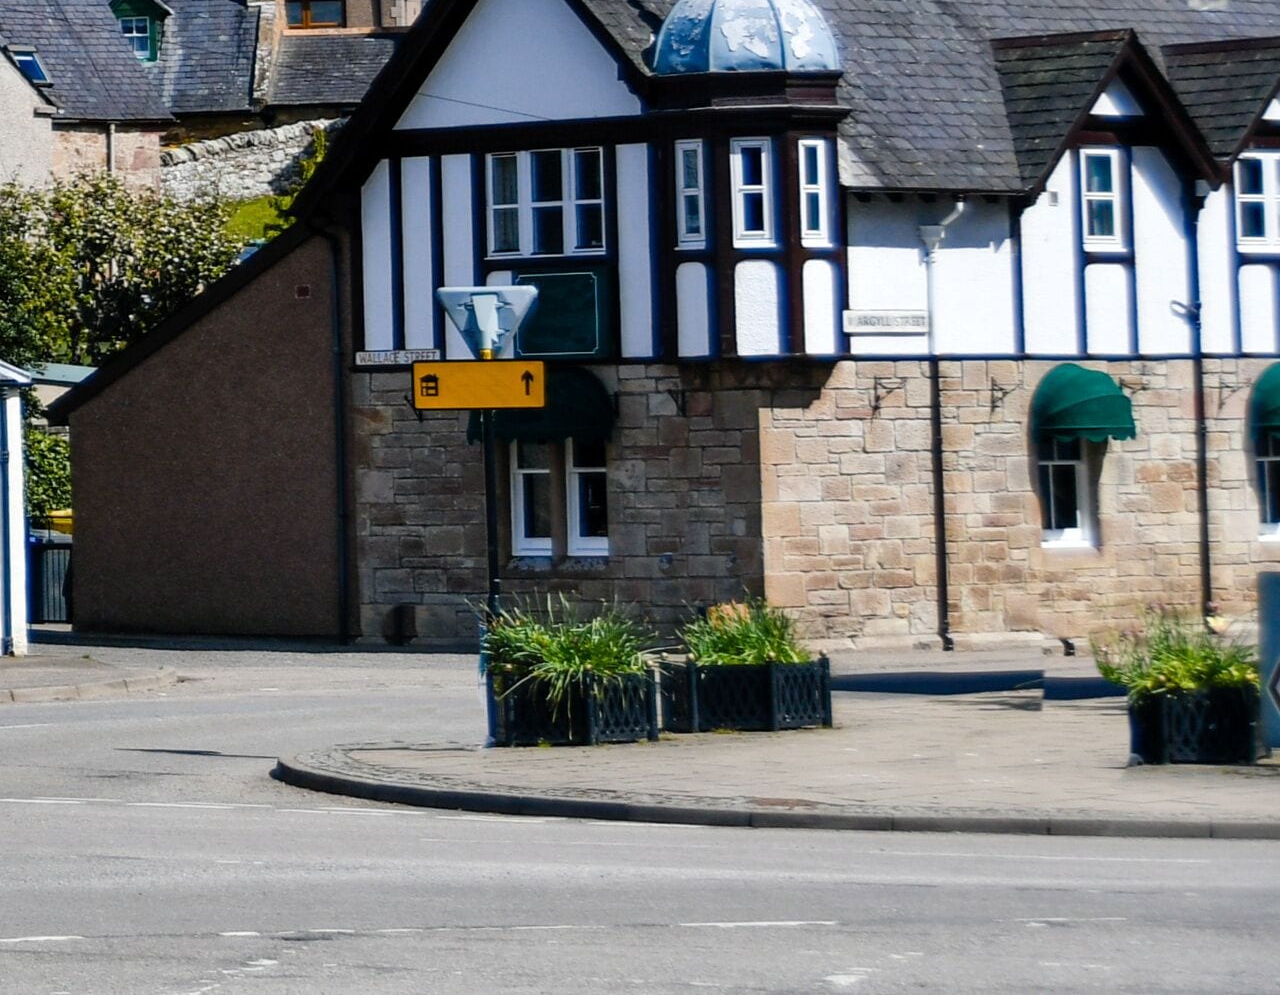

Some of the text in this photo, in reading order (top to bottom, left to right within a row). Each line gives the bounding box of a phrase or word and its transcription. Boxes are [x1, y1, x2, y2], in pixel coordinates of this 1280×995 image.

[856, 315, 927, 327] ARGYLL STREET
[358, 351, 400, 364] WALLACE
